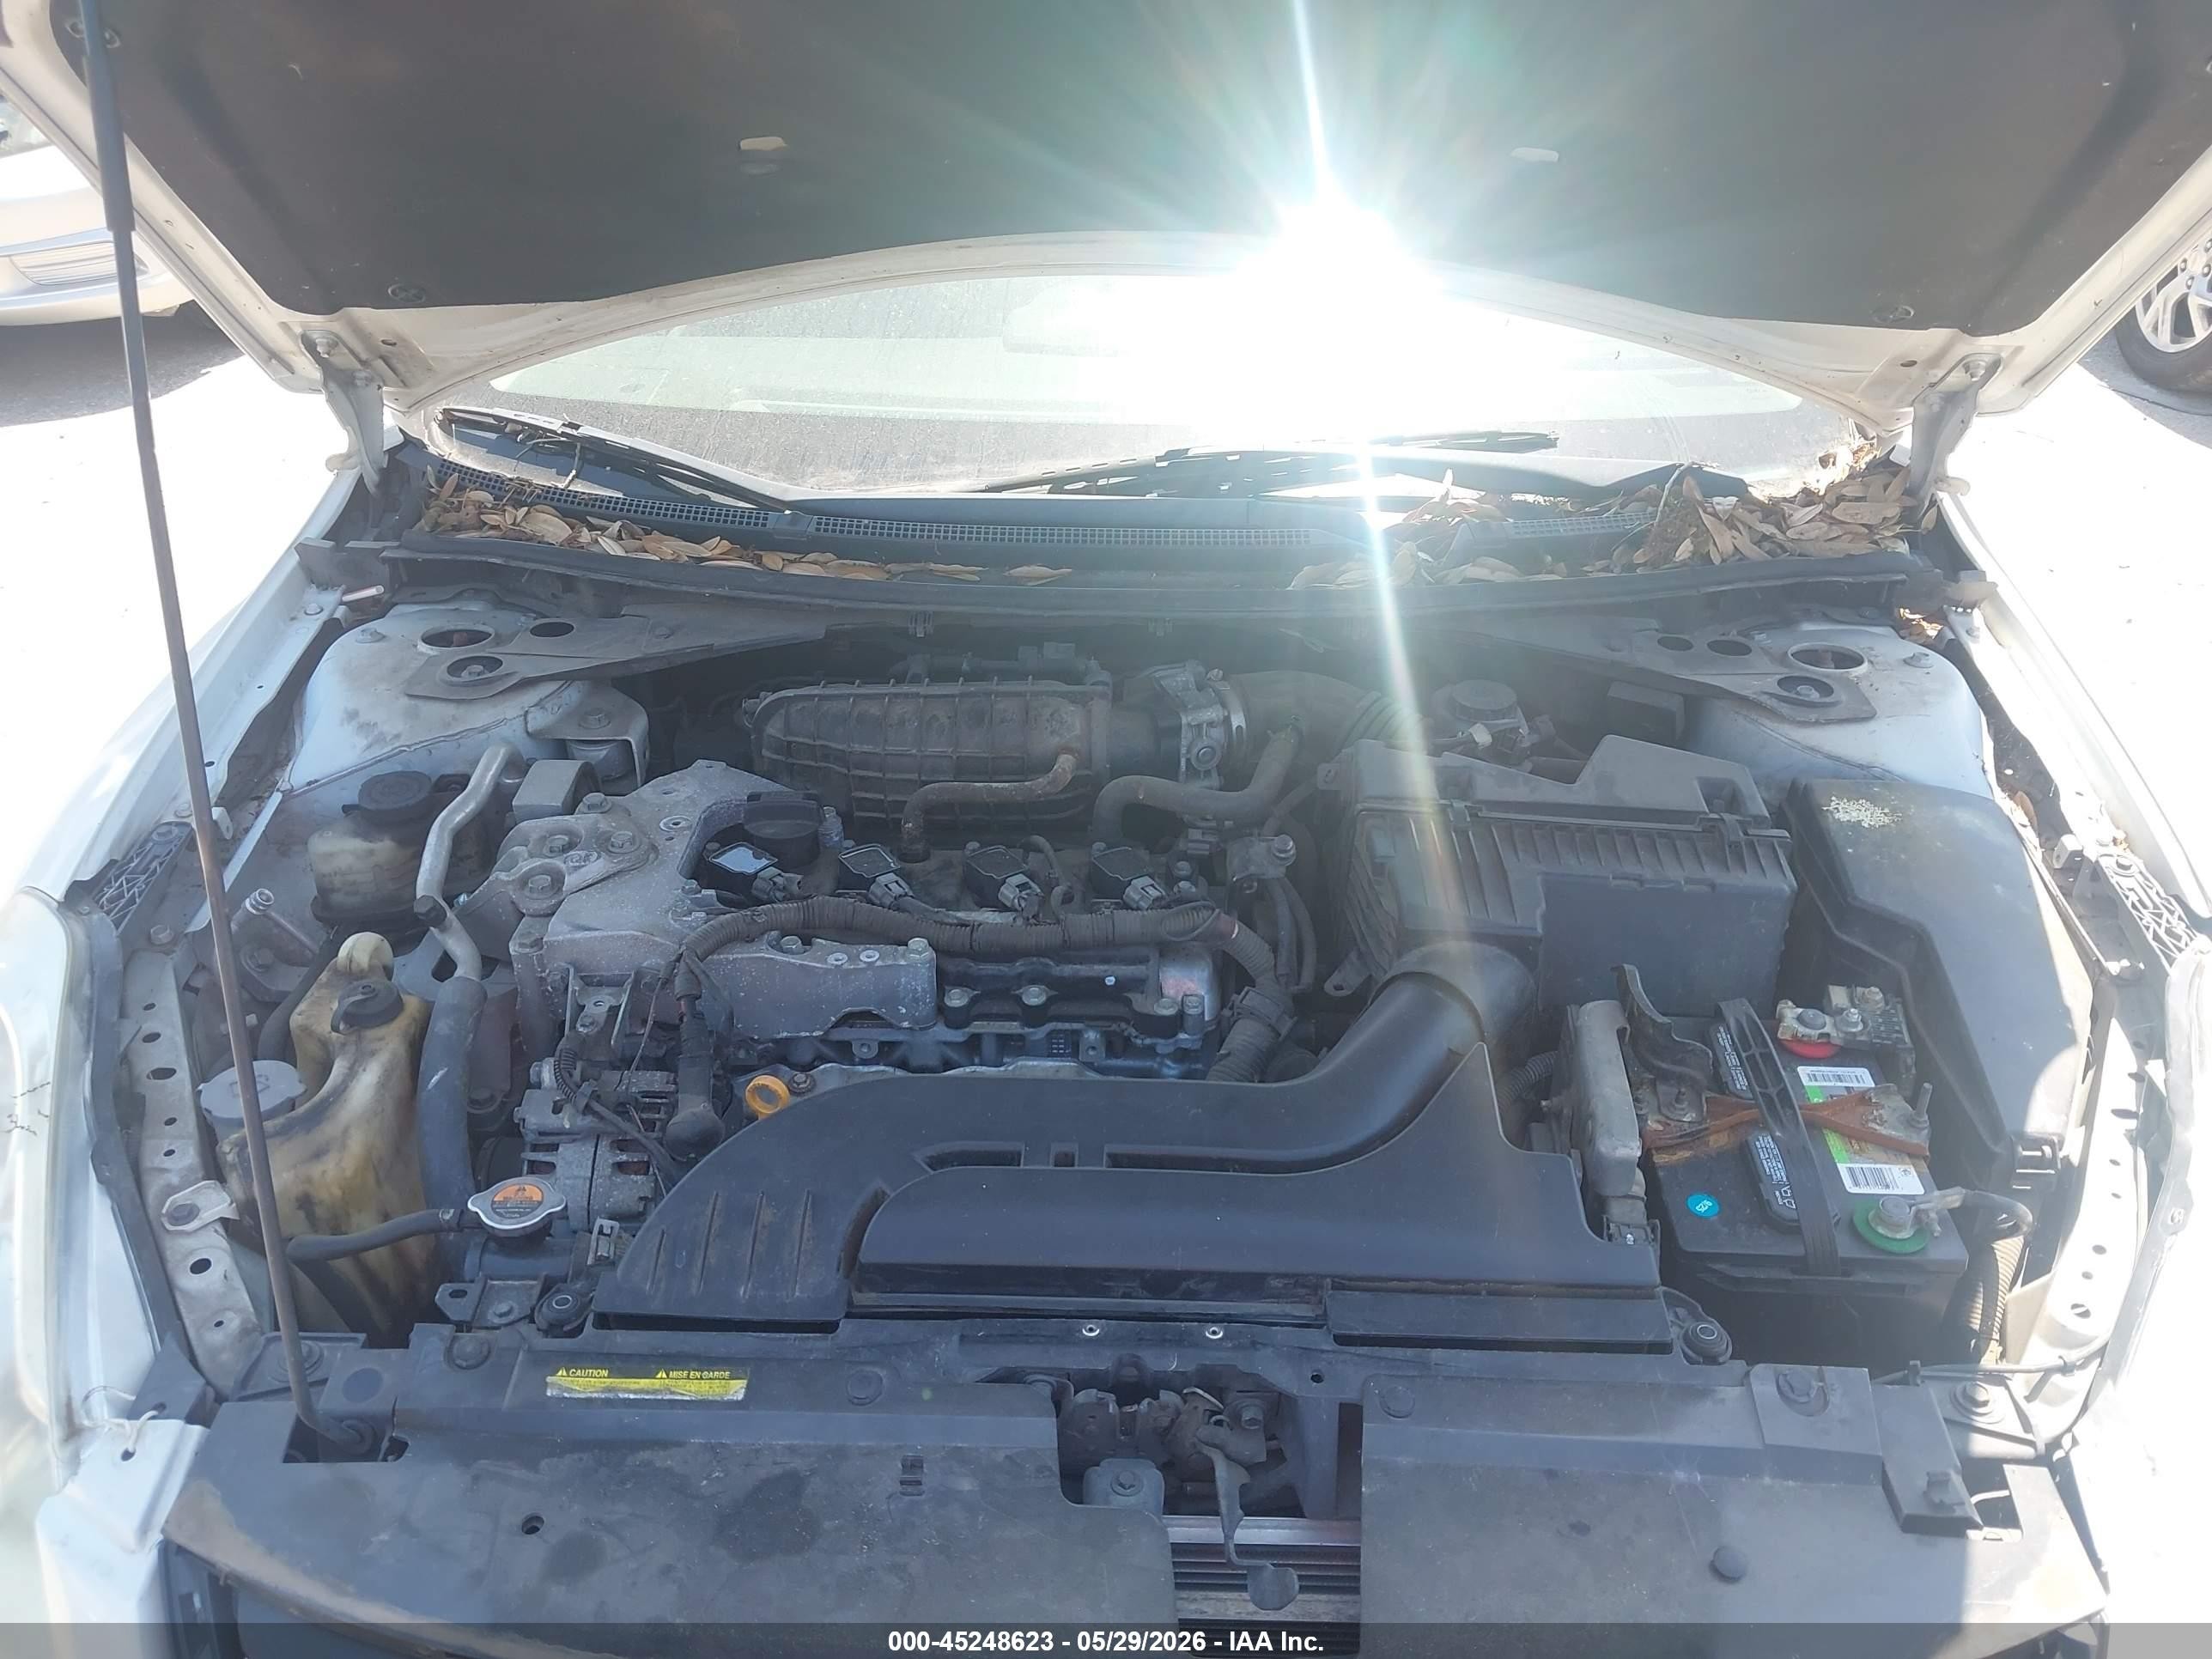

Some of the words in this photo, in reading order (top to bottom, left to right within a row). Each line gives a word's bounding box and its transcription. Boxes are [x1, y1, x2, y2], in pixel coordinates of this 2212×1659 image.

[568, 1368, 609, 1377] CAUTION
[669, 1370, 689, 1379] MISE
[689, 1370, 702, 1379] EN
